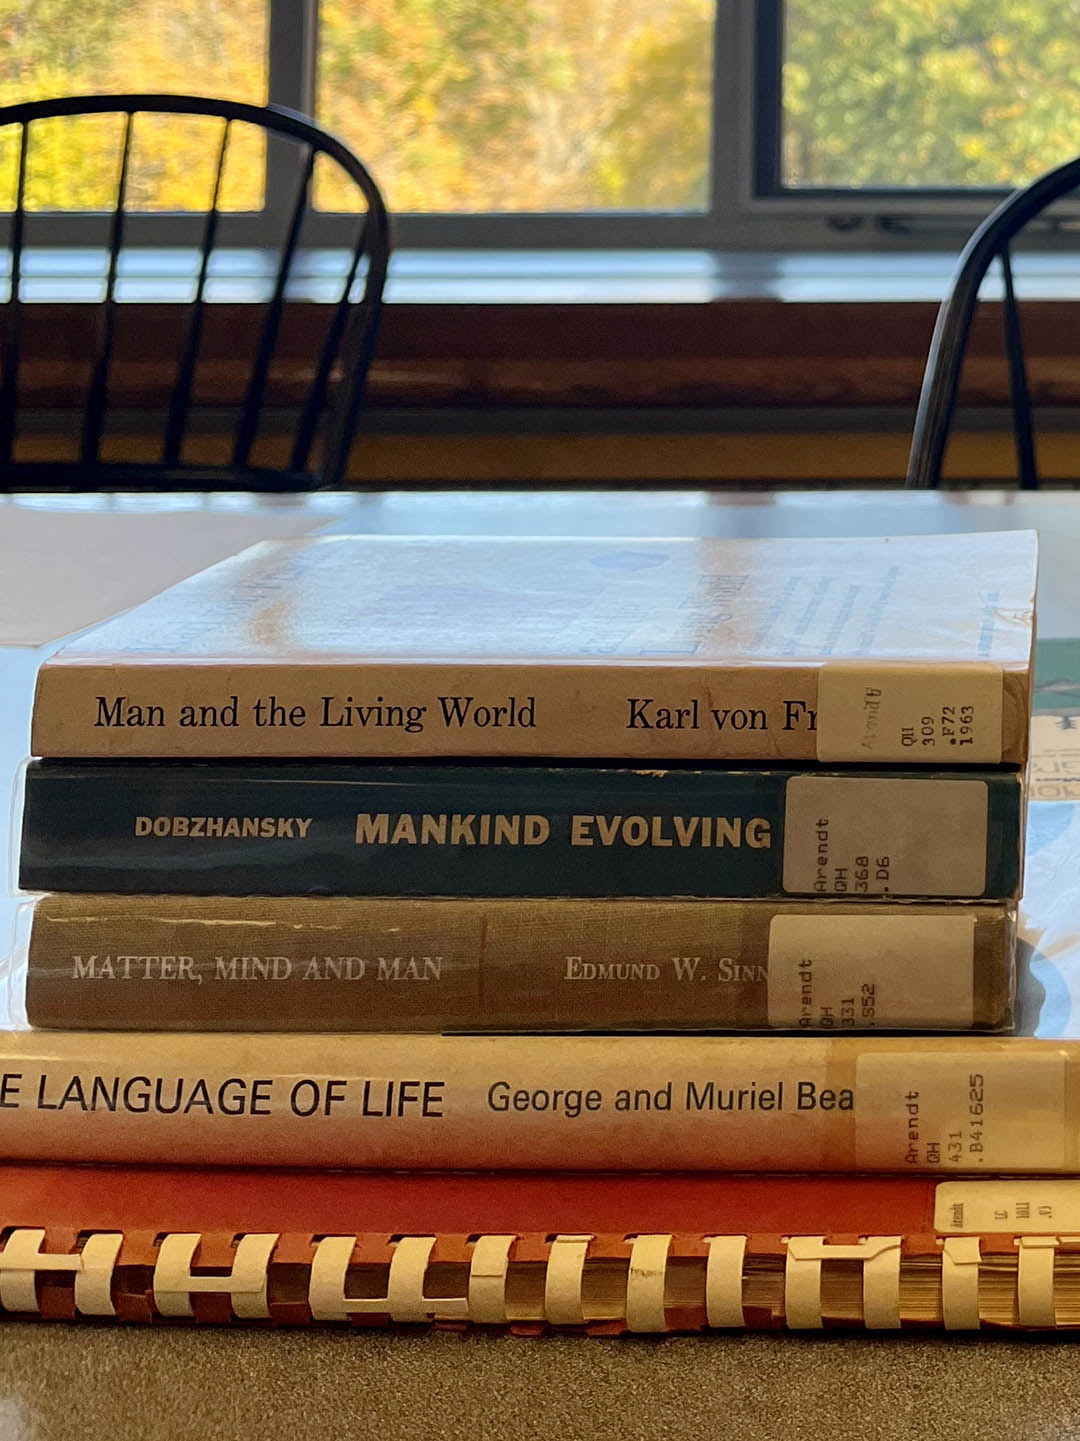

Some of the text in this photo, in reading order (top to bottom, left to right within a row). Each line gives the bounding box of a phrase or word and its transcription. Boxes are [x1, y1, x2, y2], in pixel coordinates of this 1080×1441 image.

[94, 696, 537, 733] Man and the Living World
[626, 698, 700, 729] Karl
[710, 709, 768, 730] von
[921, 716, 935, 747] 309
[942, 706, 957, 745] .F72
[960, 705, 975, 746] 1963
[901, 727, 915, 747] QH
[135, 816, 312, 838] DOBZHANSKY
[355, 813, 771, 848] MANKIND EVOLVING
[813, 818, 829, 892] Arendt
[834, 868, 849, 892] QH
[855, 856, 870, 892] 368
[876, 856, 890, 892] .D6
[72, 955, 443, 984] MATTER, MIND AND MAN
[671, 957, 706, 981] W.
[798, 958, 813, 1027] Arendt
[37, 1074, 273, 1115] LANGUAGE
[290, 1079, 348, 1117] OF
[362, 1080, 446, 1117] LIFE
[487, 1081, 602, 1117] George
[614, 1081, 672, 1111] and
[685, 1081, 783, 1111] Muriel
[904, 1090, 919, 1164] Arendt
[969, 1074, 984, 1163] .B41625
[926, 1142, 941, 1164] QH
[948, 1131, 962, 1163] 431
